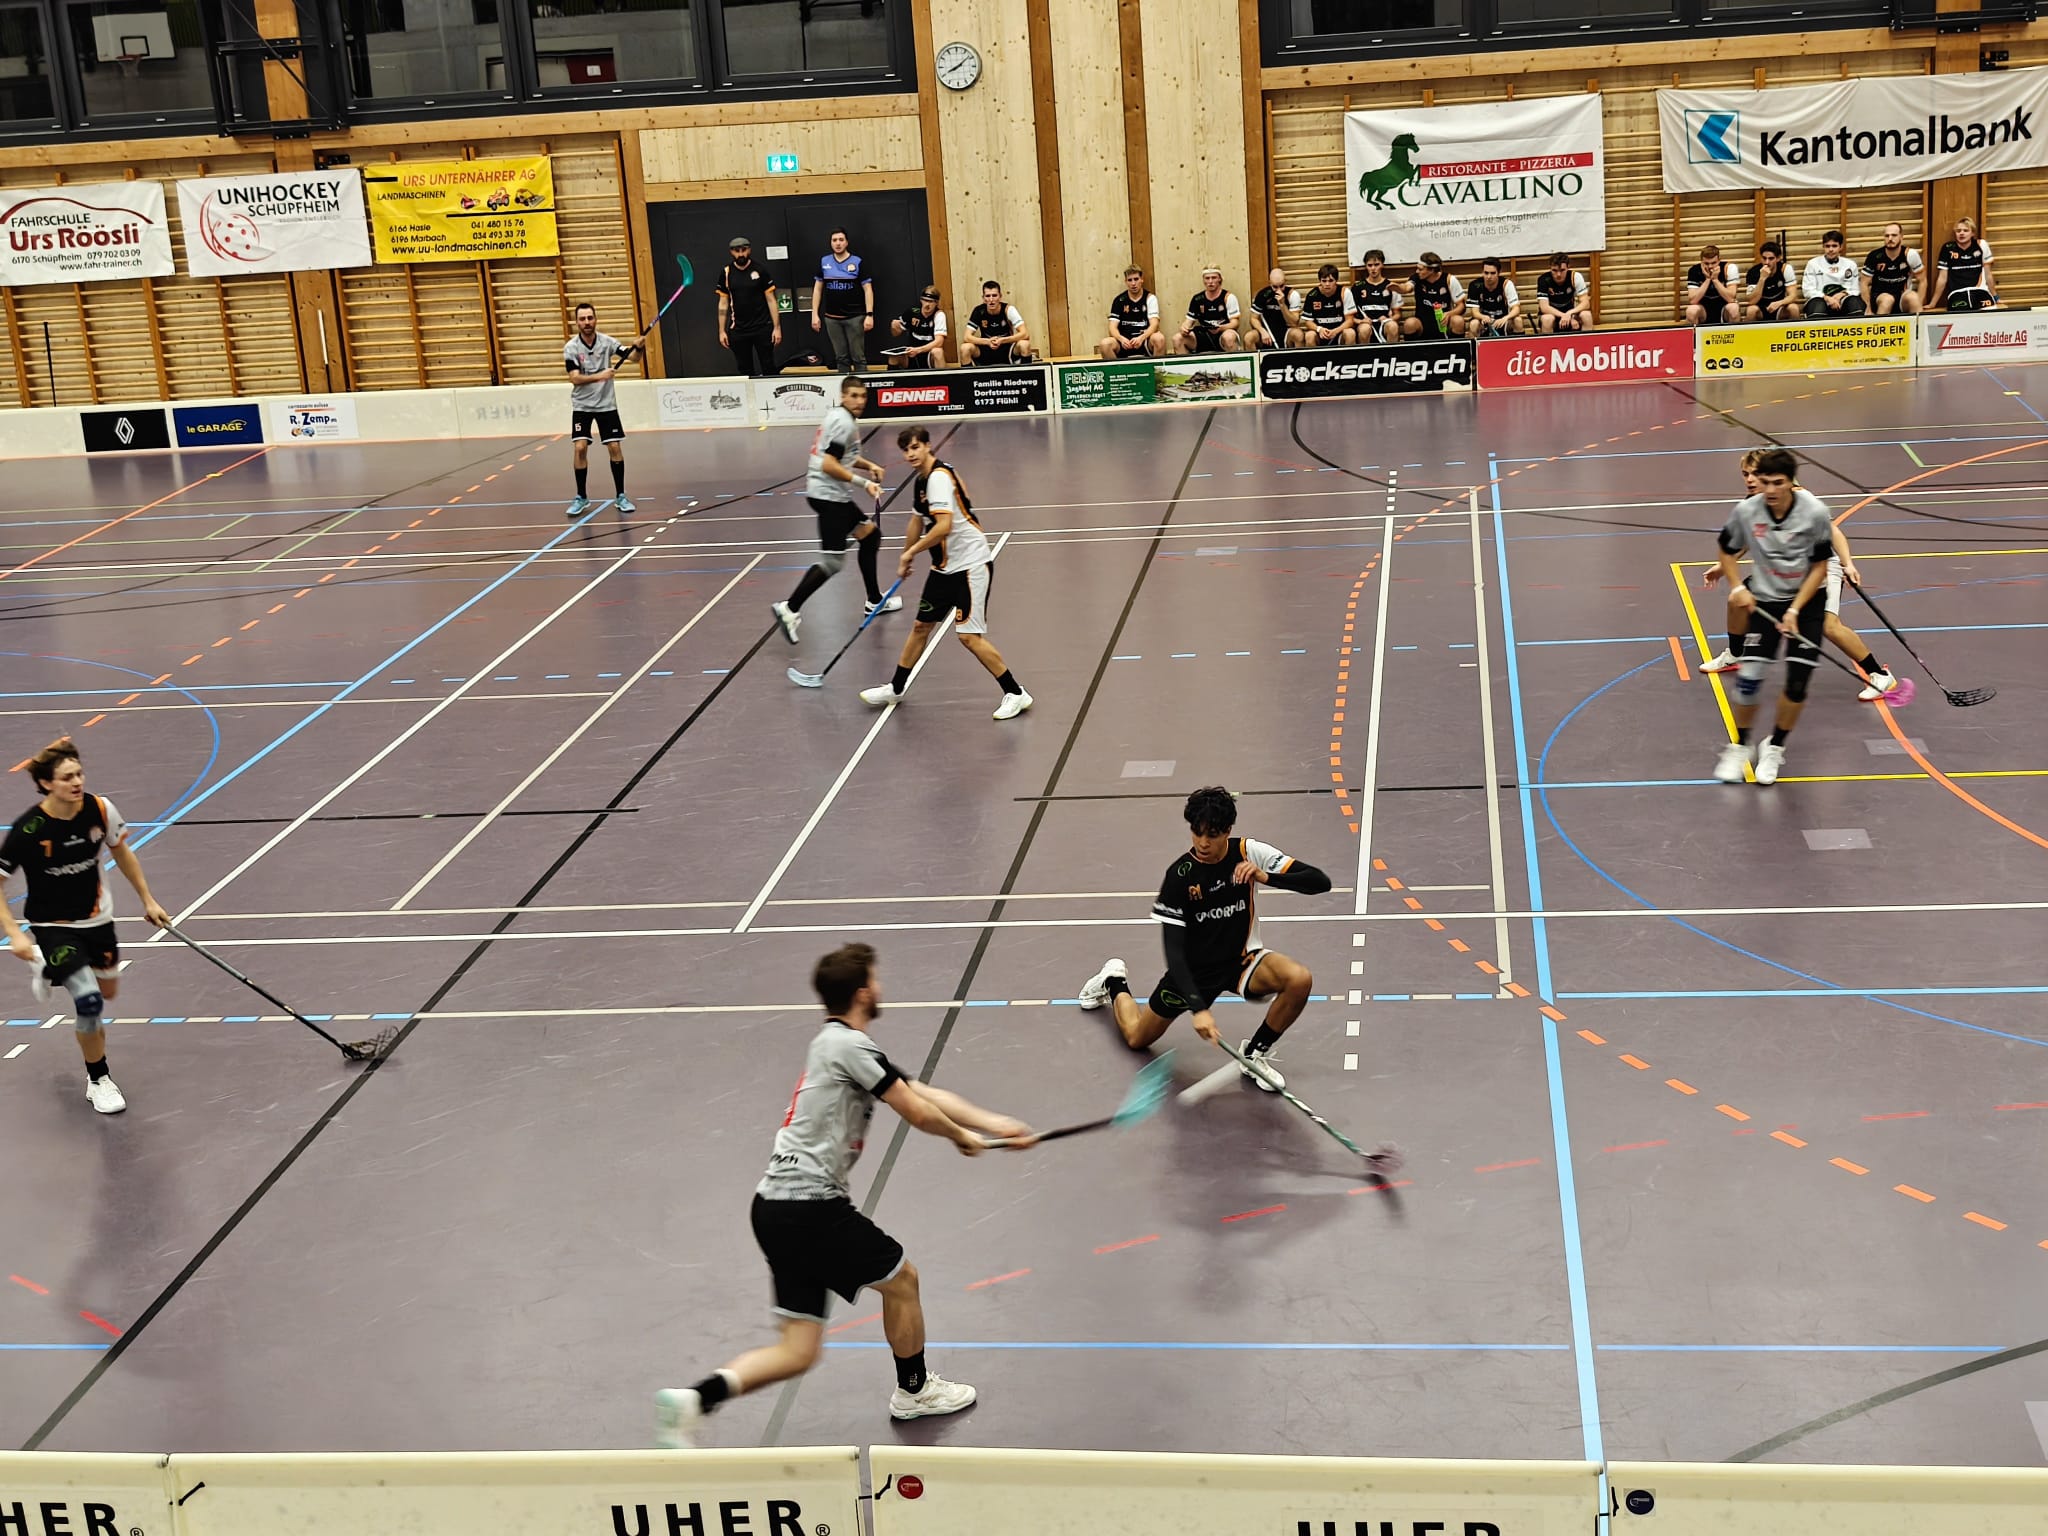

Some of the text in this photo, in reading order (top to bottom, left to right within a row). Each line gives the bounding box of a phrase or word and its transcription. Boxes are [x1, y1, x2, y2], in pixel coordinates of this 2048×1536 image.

[1760, 105, 2033, 167] Kantonalbank
[1428, 161, 1507, 177] RISTORANTE
[1519, 156, 1576, 171] PIZZERIA
[403, 169, 536, 187] URS UNTERNÄHRER AG
[217, 181, 341, 205] UNIHOCKEY
[377, 190, 446, 201] LANDMASCHINEN
[1398, 172, 1583, 207] CAVALLINO
[248, 199, 340, 217] SCHÜPFHEIM
[11, 213, 91, 228] FAHRSCHULE
[471, 221, 484, 229] 041
[487, 220, 501, 228] 480
[504, 219, 513, 227] 15
[9, 223, 140, 252] Urs Röösli
[411, 233, 446, 243] Marbach
[473, 231, 486, 240] 034
[504, 230, 514, 238] 33
[516, 229, 526, 237] 78
[1429, 224, 1521, 239] Telefon 041 485 05 25
[392, 239, 527, 254] www.uu-landmaschinen.ch
[12, 249, 141, 265] 6170 Schüpfheim 079 702 03 09
[59, 258, 142, 271] www.fahr-trainer.ch
[1786, 324, 1906, 340] DER STEILPASS FÜR EIN
[1937, 323, 1981, 350] Zimmerei
[1984, 331, 2012, 344] Stalder
[2015, 330, 2027, 343] AG
[1771, 337, 1854, 353] ERFOLGREICHES
[1507, 344, 1664, 376] die Mobiliar
[973, 379, 1038, 388] Familie Riedweg
[880, 389, 946, 404] DENNER
[974, 389, 1020, 397] Dorfstrasse
[975, 397, 1019, 406] 6173 Flühli
[302, 412, 330, 425] Zemp
[187, 422, 244, 434] le GARAGE
[611, 1499, 806, 1536] UHER
